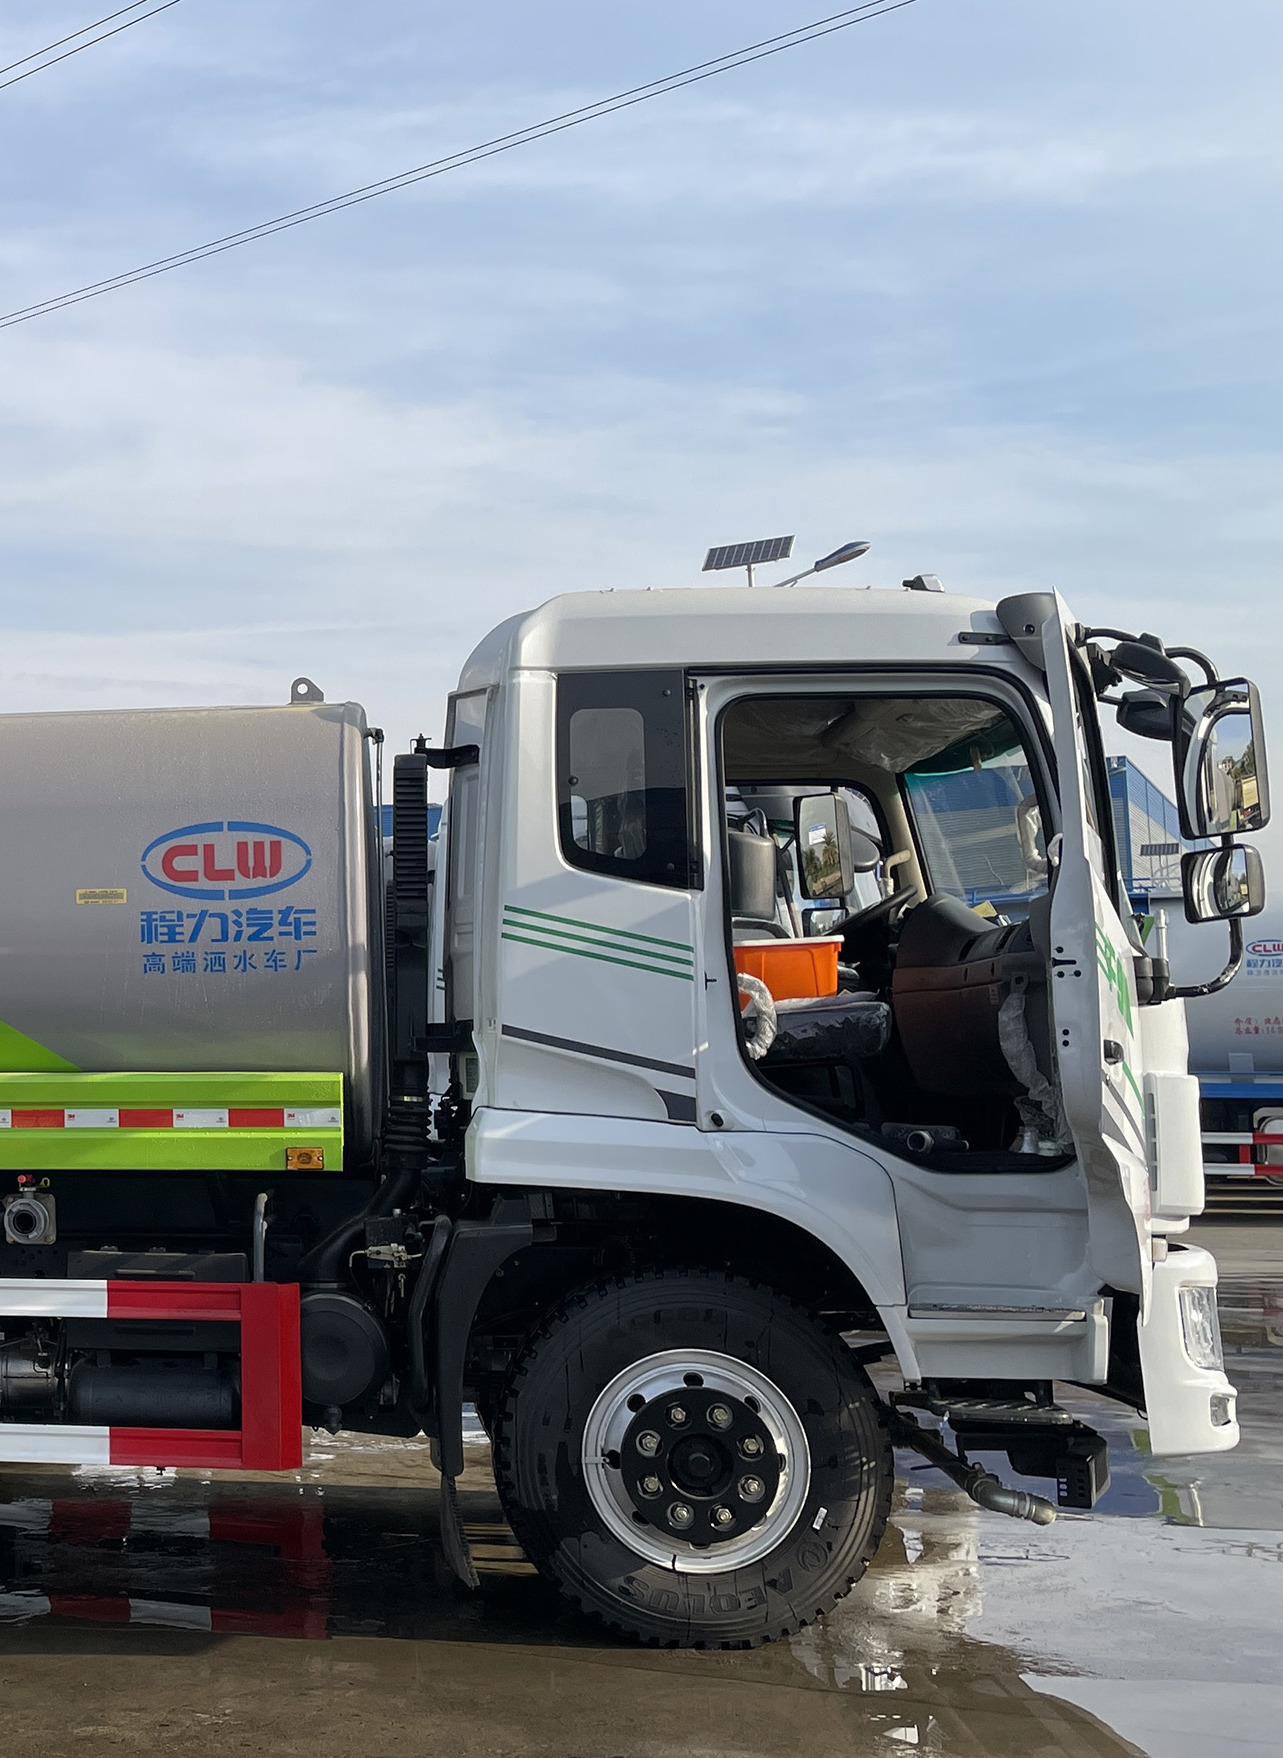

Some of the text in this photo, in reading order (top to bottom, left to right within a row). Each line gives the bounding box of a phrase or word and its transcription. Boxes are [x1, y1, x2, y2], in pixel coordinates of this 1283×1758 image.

[162, 840, 282, 882] CLW
[140, 906, 317, 945] 程力汽车
[142, 949, 318, 974] 高端洒水车厂
